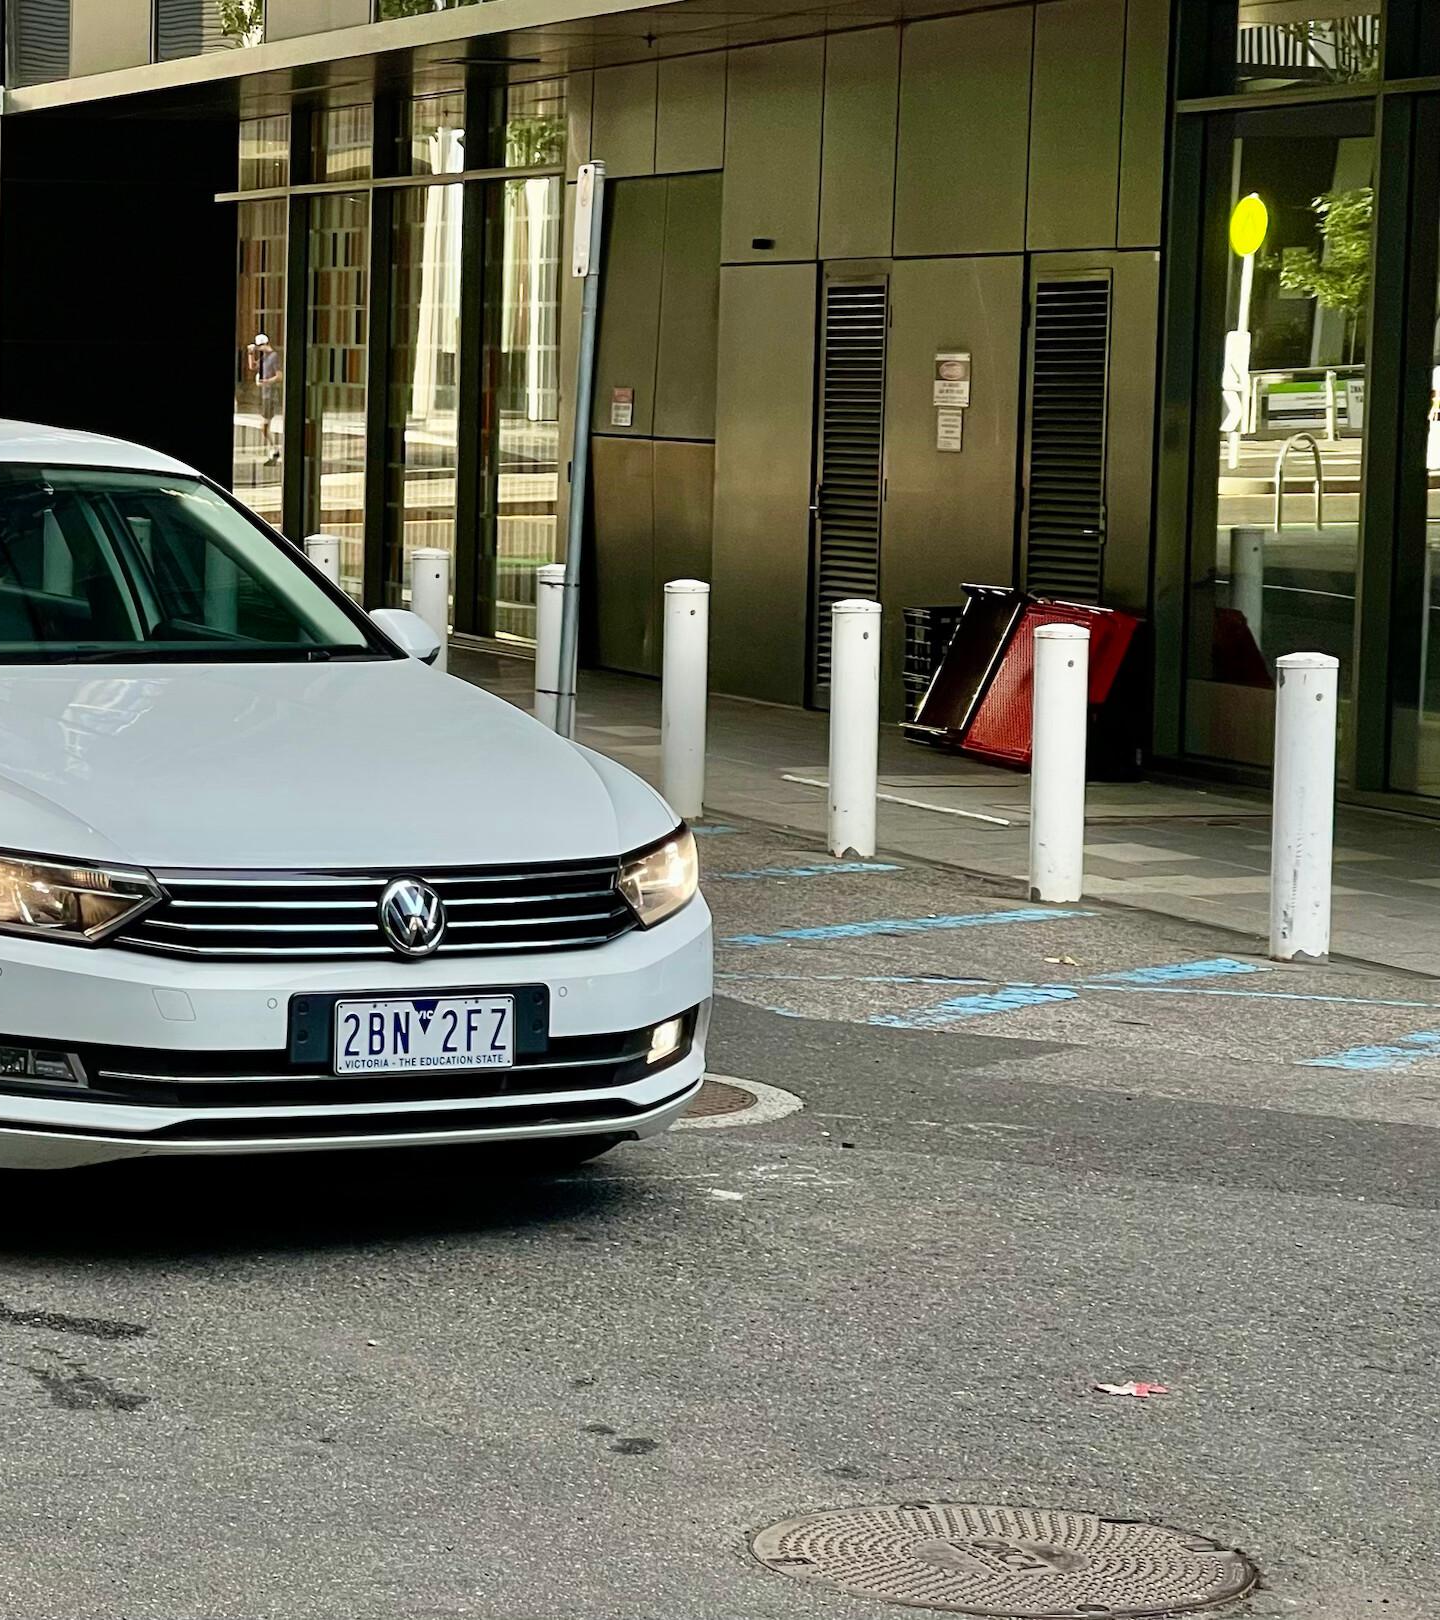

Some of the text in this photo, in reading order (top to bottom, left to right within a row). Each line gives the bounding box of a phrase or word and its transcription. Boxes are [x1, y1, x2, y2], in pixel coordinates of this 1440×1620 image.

[344, 1008, 507, 1057] 2BN 2FZ
[345, 1058, 389, 1069] VICTORIA
[399, 1058, 417, 1067] THE
[420, 1055, 473, 1066] EDUCATION
[475, 1054, 504, 1064] STATE
